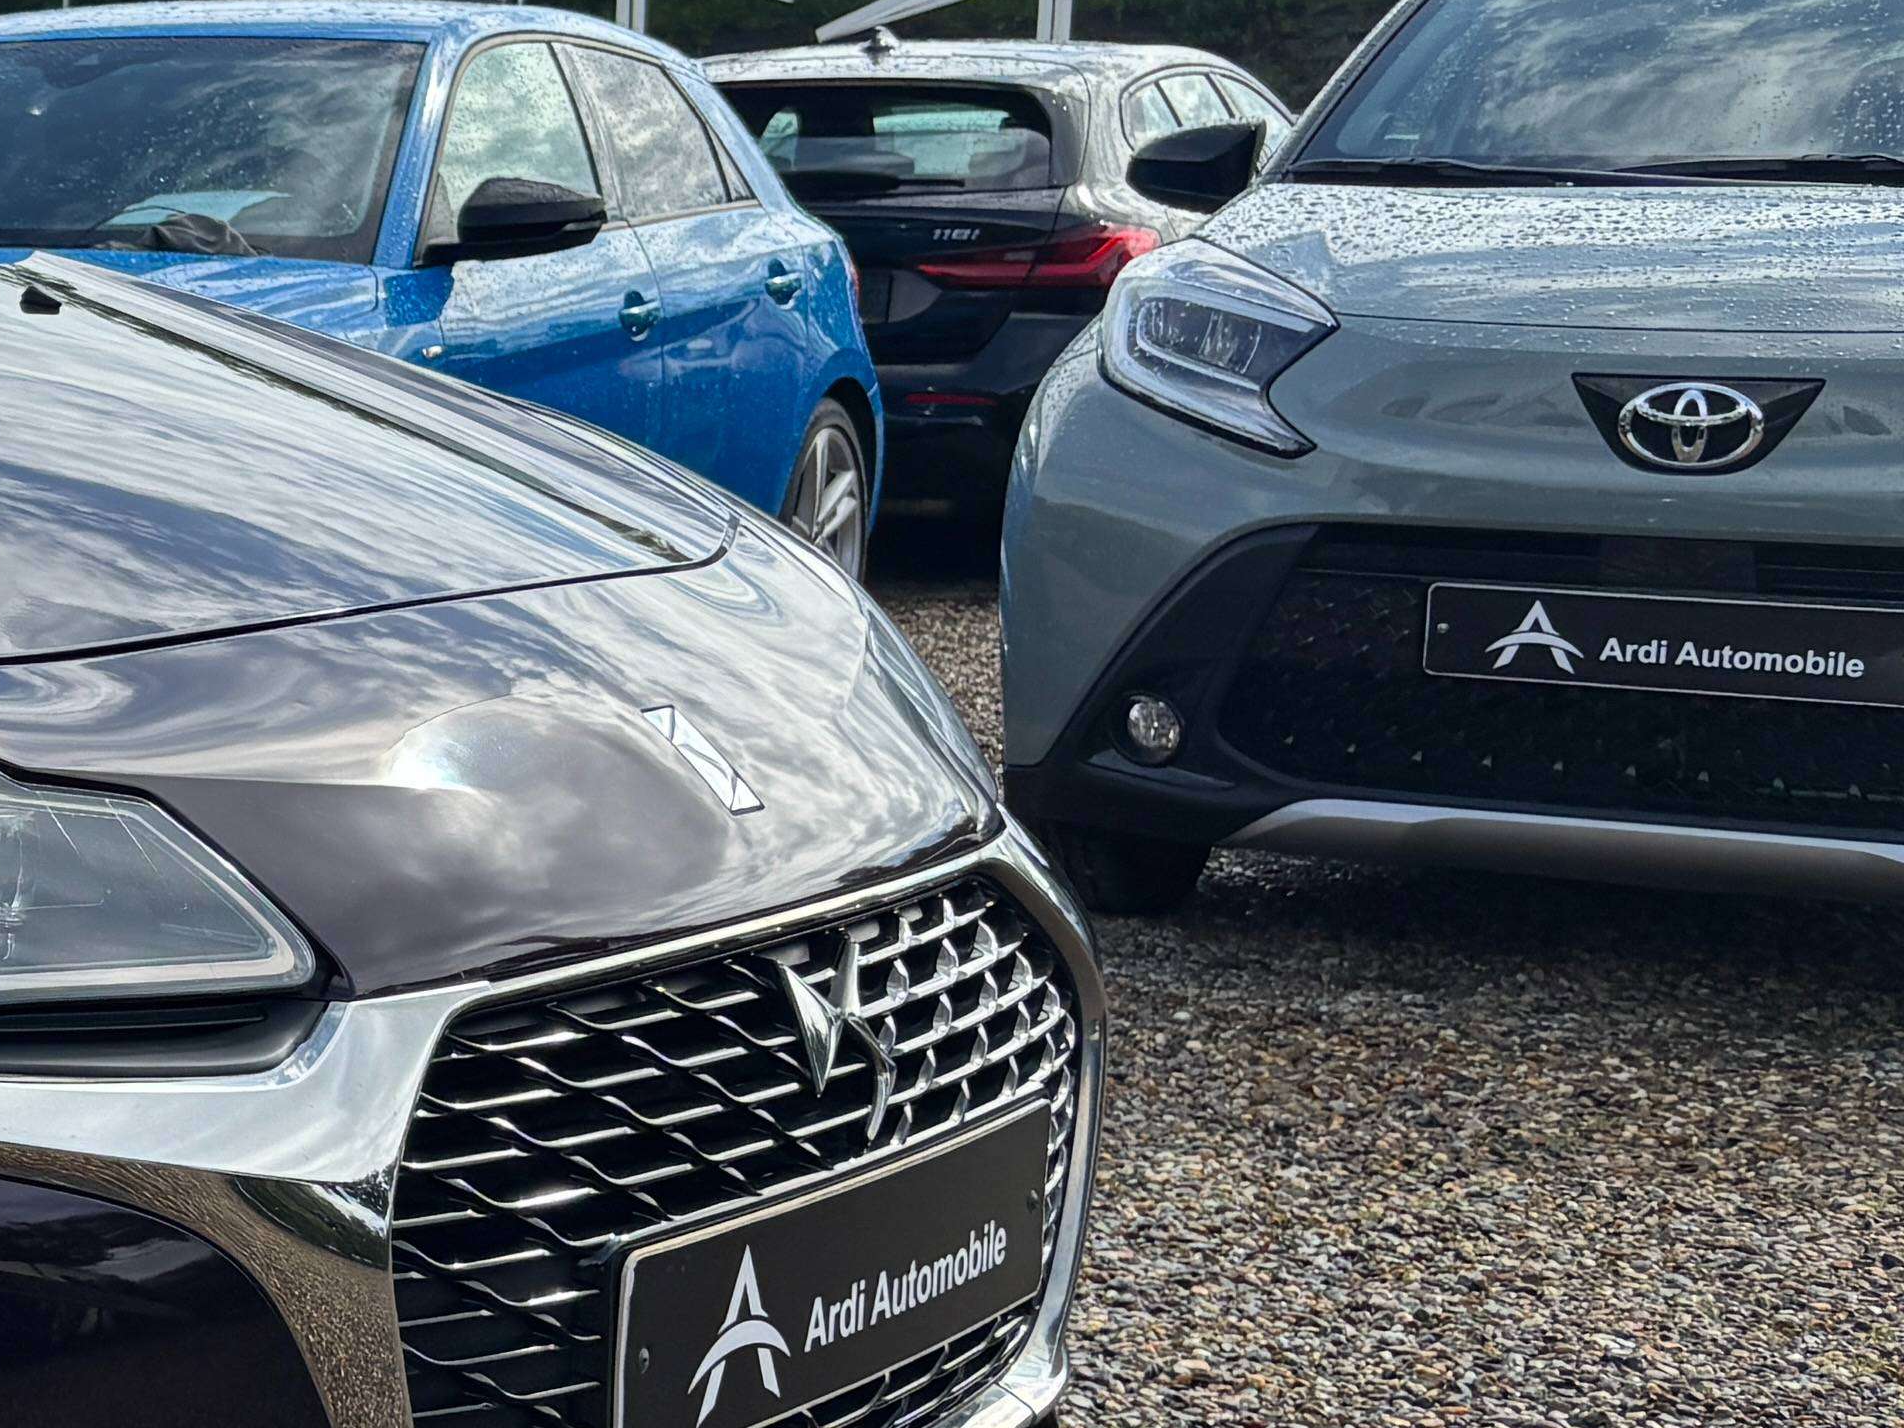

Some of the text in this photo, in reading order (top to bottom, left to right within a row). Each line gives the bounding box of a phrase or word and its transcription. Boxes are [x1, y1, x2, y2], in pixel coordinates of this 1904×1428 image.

[1599, 637, 1865, 678] Ardi Automobile
[804, 1219, 1007, 1353] Ardi Automobile
